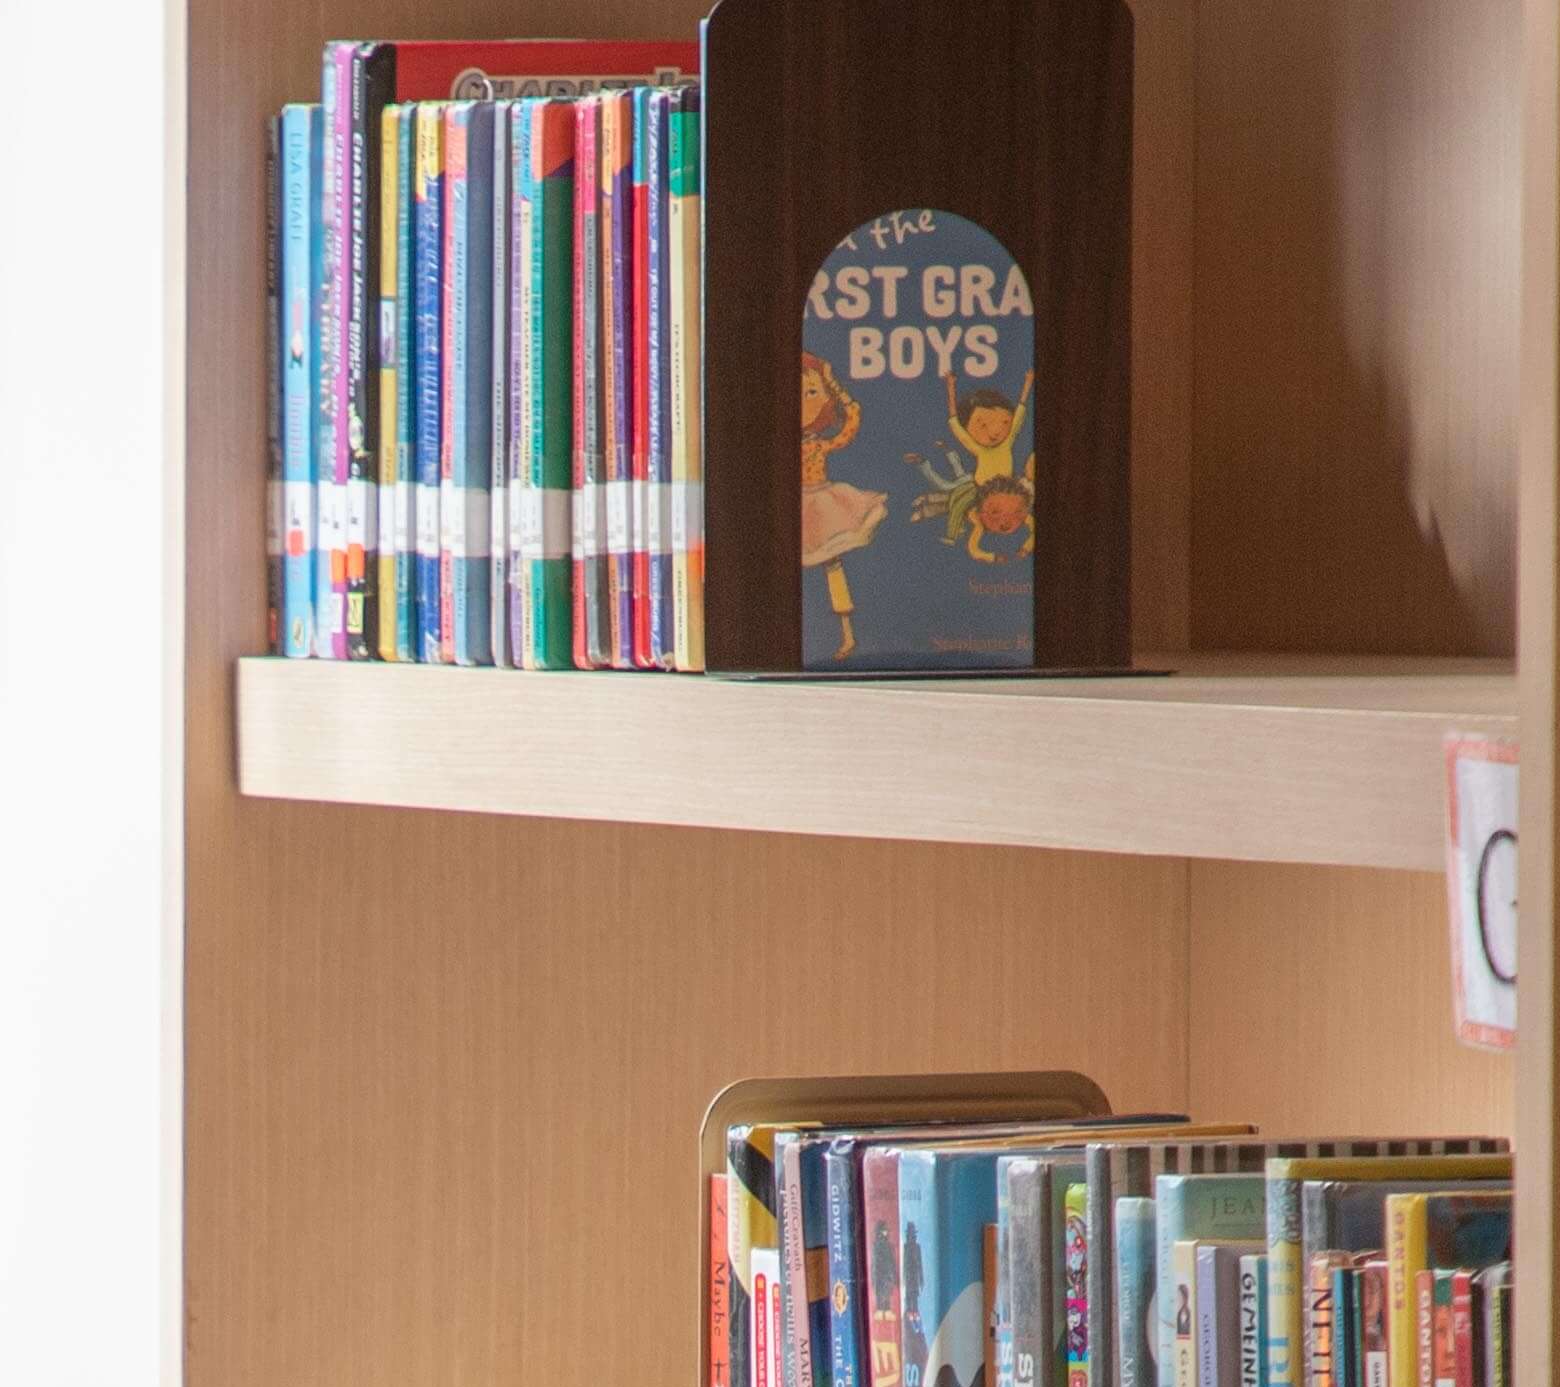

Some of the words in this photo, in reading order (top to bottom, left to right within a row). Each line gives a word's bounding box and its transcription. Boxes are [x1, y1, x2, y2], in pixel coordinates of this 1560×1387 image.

[290, 132, 304, 174] LISA
[870, 209, 937, 249] the
[849, 324, 999, 380] BOYS
[832, 1184, 845, 1264] GIDWITZ
[1211, 1196, 1266, 1219] JEA
[1393, 1210, 1406, 1312] GANTOS
[835, 1335, 846, 1371] THE
